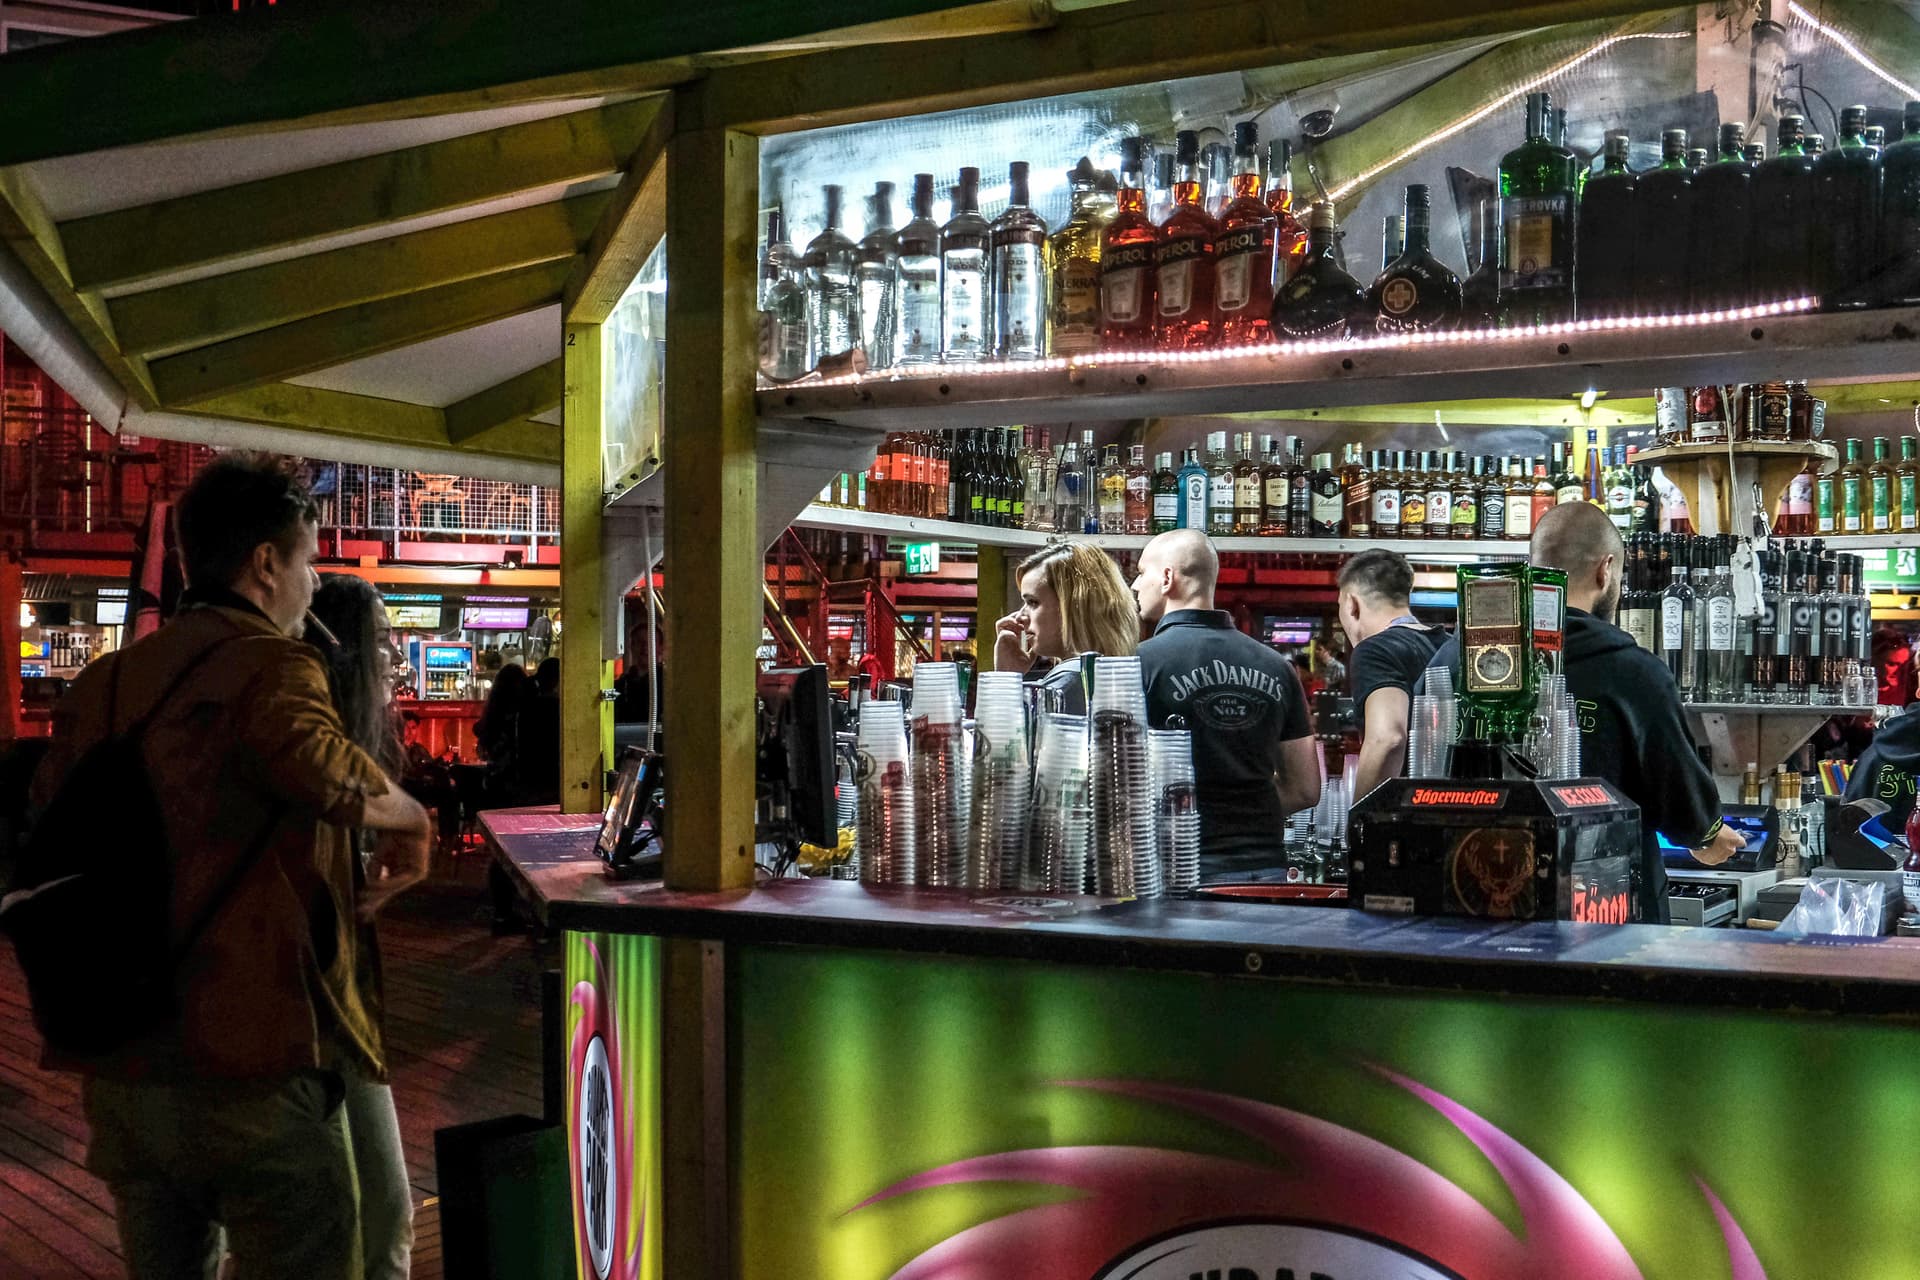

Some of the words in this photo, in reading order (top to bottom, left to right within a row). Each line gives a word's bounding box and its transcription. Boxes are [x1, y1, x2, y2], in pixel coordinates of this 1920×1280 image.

[567, 333, 576, 346] 2
[1169, 665, 1215, 701] JACK
[1213, 659, 1283, 702] DANIEL'S
